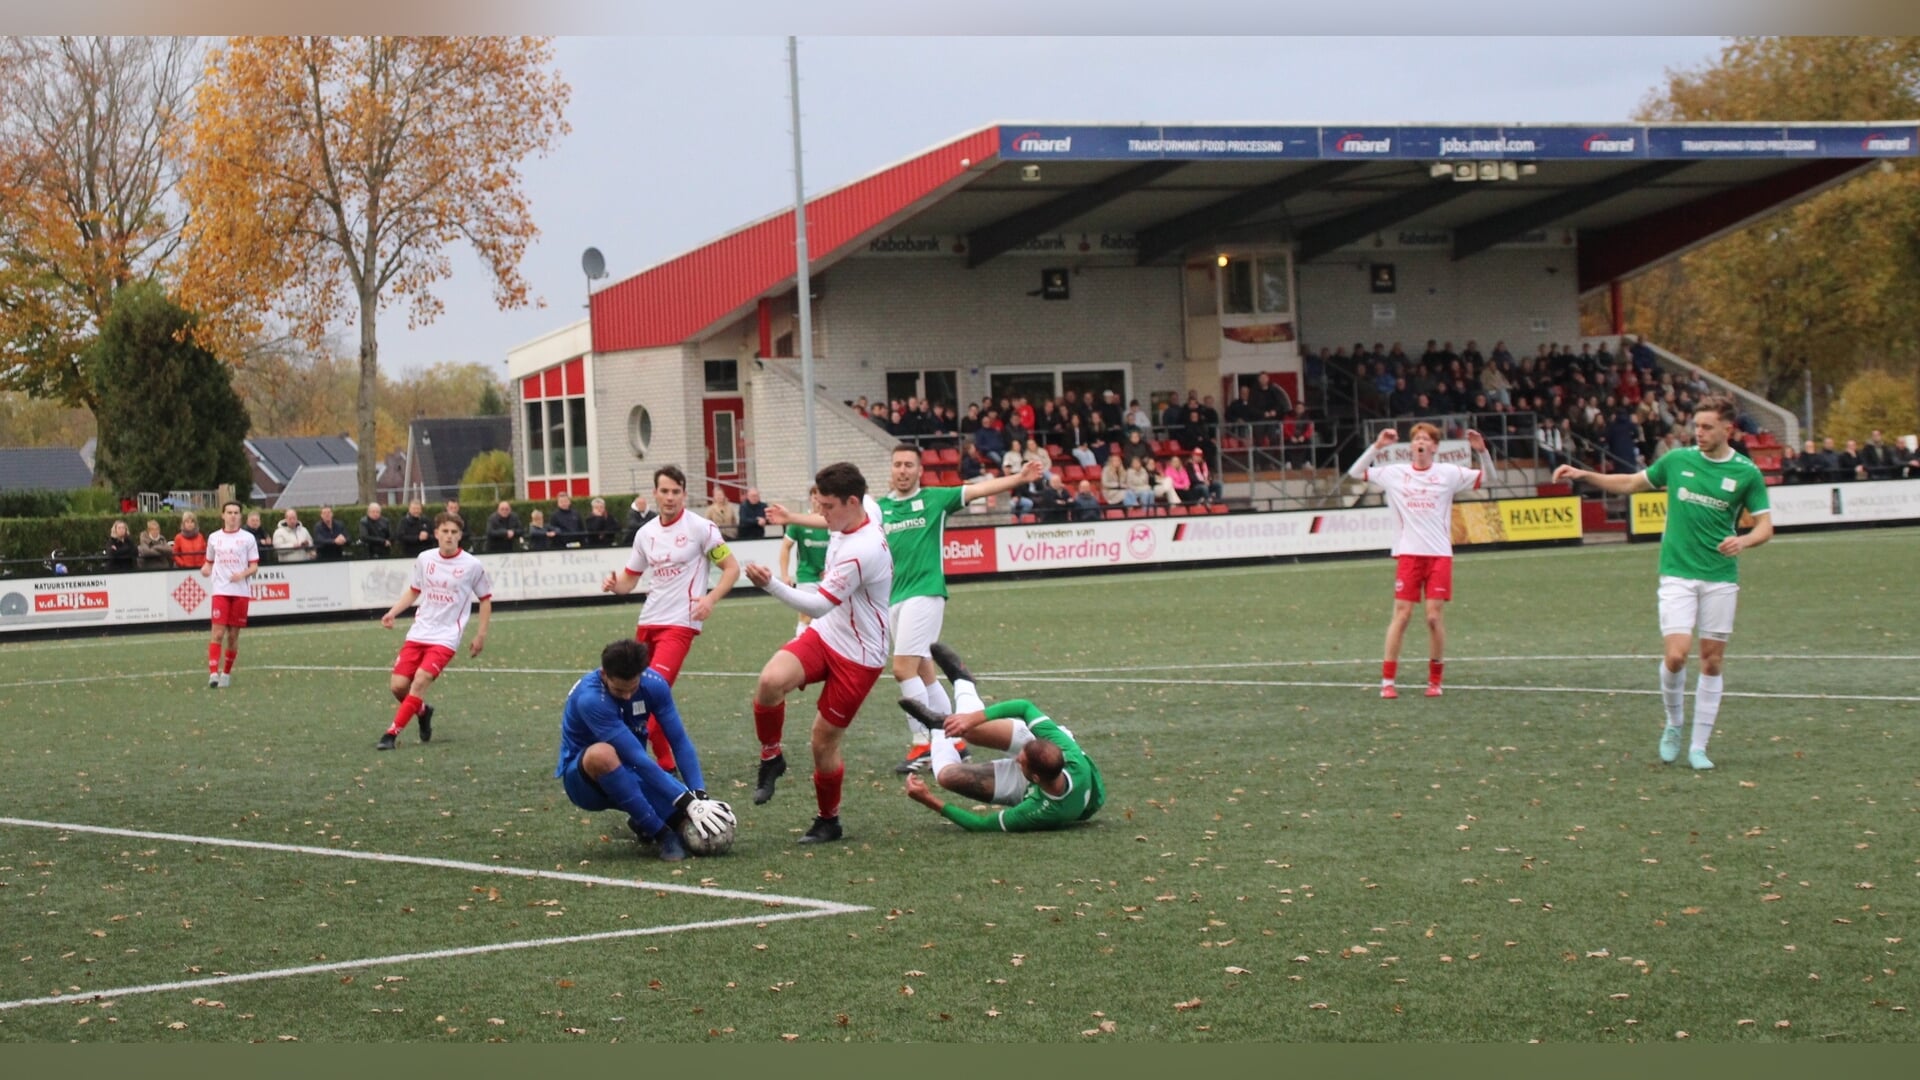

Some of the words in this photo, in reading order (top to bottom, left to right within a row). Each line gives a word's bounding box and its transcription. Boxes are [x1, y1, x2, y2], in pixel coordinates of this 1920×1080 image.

[1019, 136, 1071, 152] marel
[1127, 139, 1200, 152] TRANSFORMING
[1201, 139, 1226, 152] FOOD
[1227, 139, 1284, 153] PROCESSING
[1341, 137, 1391, 152] marel
[1439, 137, 1535, 155] jobs.marel.com
[1587, 137, 1635, 152] marel
[1866, 137, 1911, 151] marel
[869, 235, 941, 251] Rabobank
[1326, 514, 1393, 533] Molen
[1509, 506, 1574, 525] HAVENS
[1025, 528, 1074, 540] Vrienden
[1076, 527, 1096, 537] van
[1190, 521, 1299, 541] Molenaar
[943, 538, 985, 560] oBank
[1007, 540, 1122, 562] Volharding
[426, 563, 436, 576] 18
